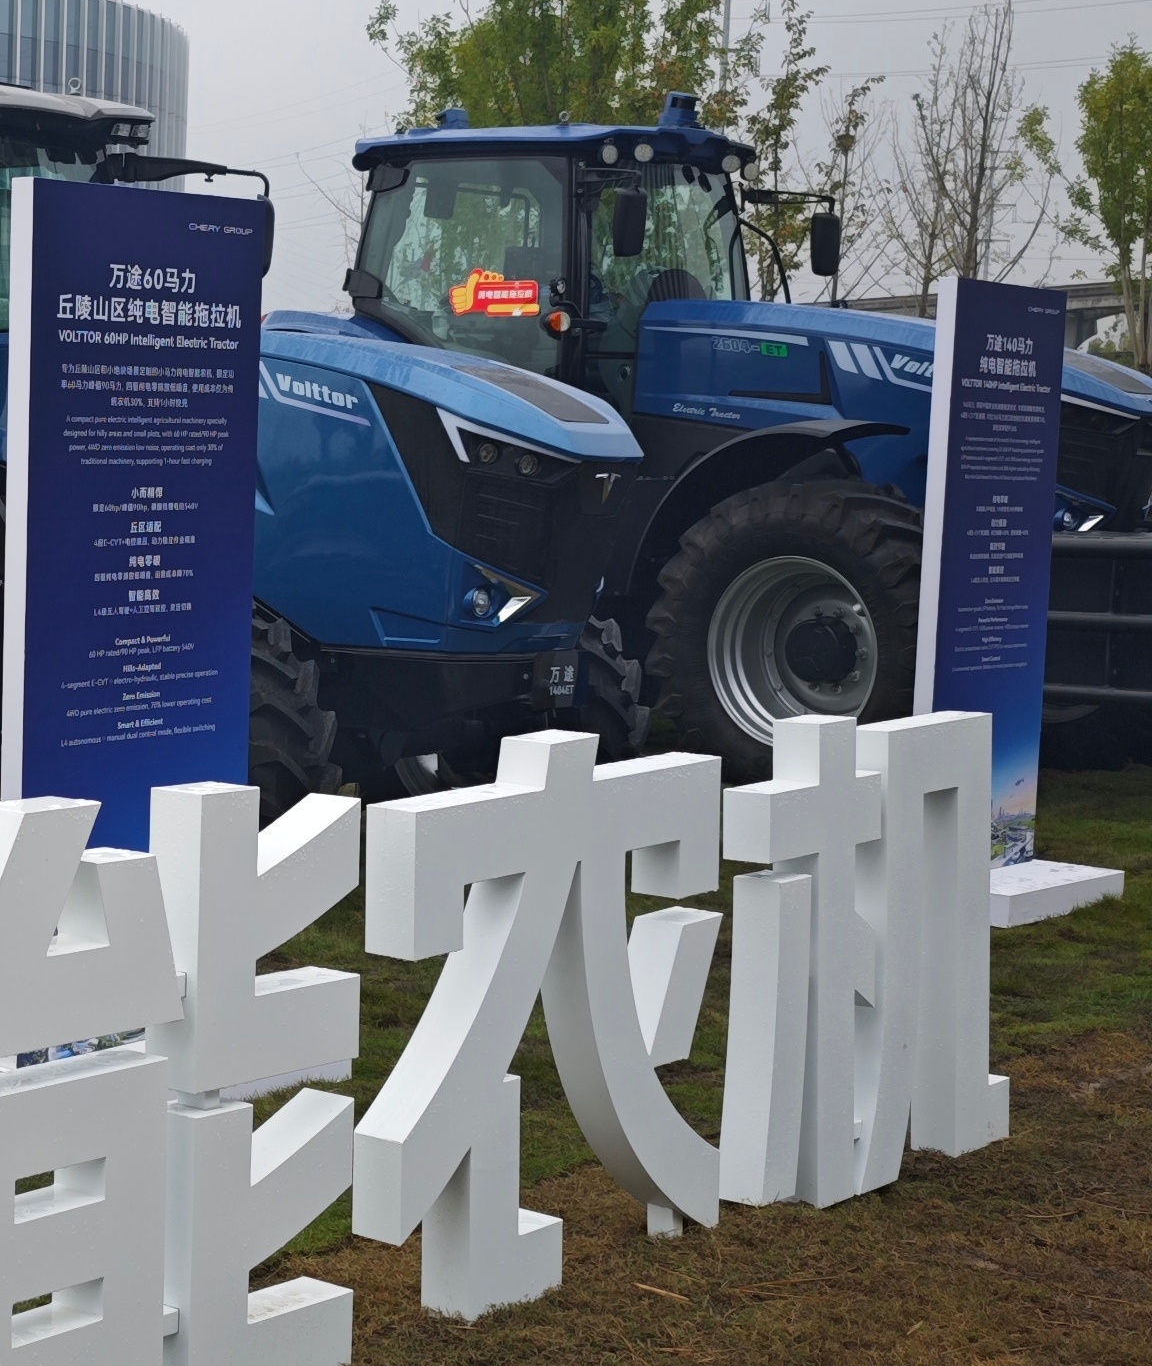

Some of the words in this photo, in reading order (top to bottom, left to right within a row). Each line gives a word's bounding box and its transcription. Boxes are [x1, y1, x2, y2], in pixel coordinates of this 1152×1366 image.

[188, 223, 221, 232] CHERY
[223, 226, 253, 235] GROUP
[109, 263, 196, 294] 万途60马力
[56, 293, 242, 328] 丘陵山区纯电智能拖拉机
[58, 329, 102, 343] VOLTTOR
[104, 331, 129, 344] 60HP
[130, 333, 175, 350] Intelligent
[176, 336, 208, 349] Electric
[209, 337, 239, 350] Tractor
[985, 334, 1033, 355] 万途140马力
[979, 356, 1037, 377] 纯电智能拖拉机
[276, 373, 359, 409] Volttor
[672, 402, 706, 417] Electric
[708, 407, 742, 420] Tractor
[115, 637, 140, 646] Compact
[146, 634, 171, 644] Powerful
[97, 649, 105, 657] HP
[129, 647, 137, 655] HP
[549, 665, 575, 683] 万途
